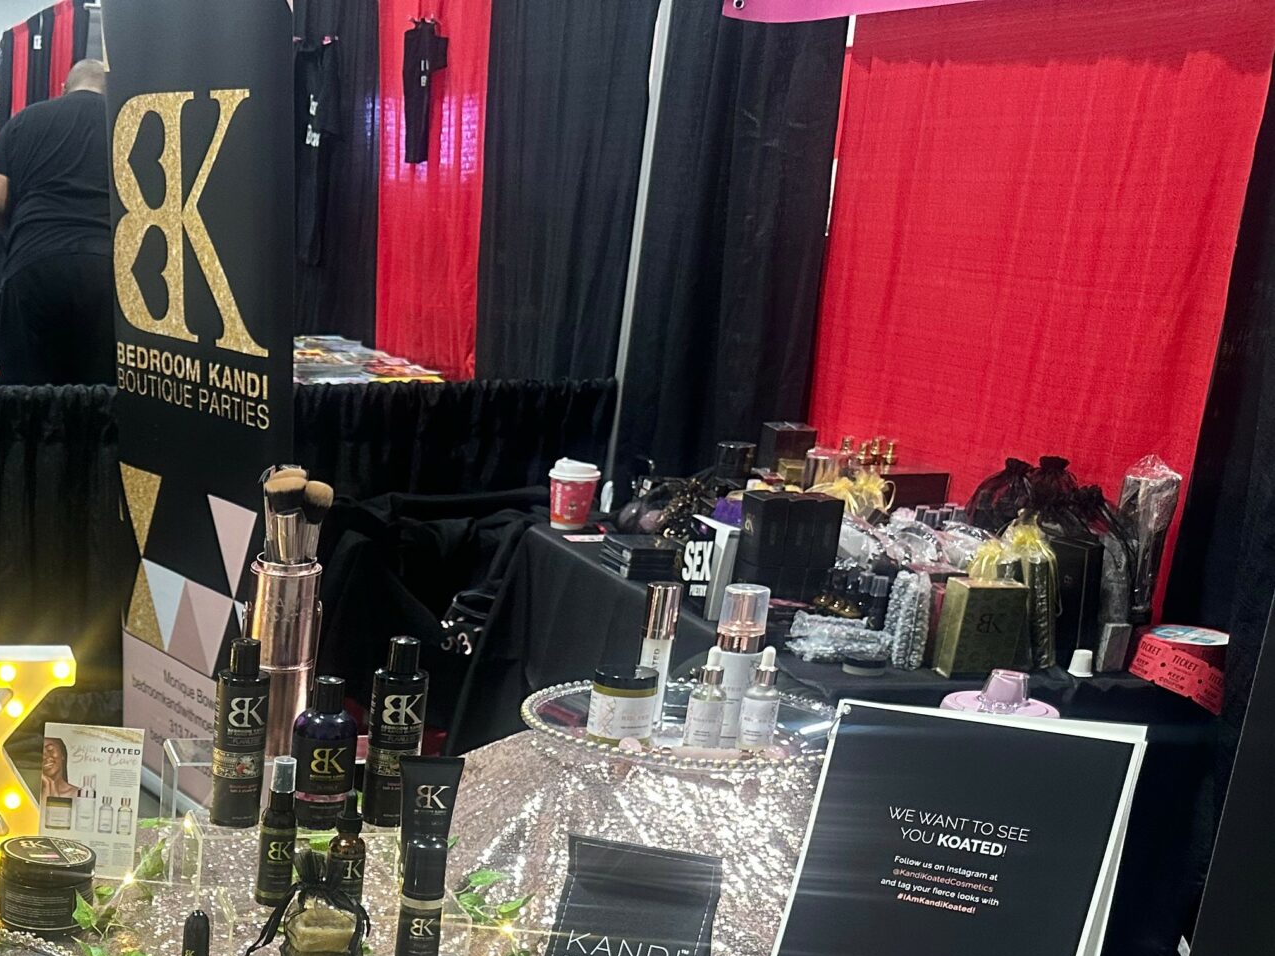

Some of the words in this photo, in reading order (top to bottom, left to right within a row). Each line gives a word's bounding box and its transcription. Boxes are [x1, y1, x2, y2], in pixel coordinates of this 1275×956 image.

[116, 341, 201, 384] BEDROOM
[208, 363, 269, 400] KANDI
[116, 367, 193, 410] BOUTIQUE
[198, 388, 270, 430] PARTIES
[682, 540, 714, 581] SEX
[1140, 641, 1162, 656] TICKET
[1172, 655, 1200, 672] TICKET
[228, 695, 267, 728] BK
[382, 693, 424, 726] BK
[101, 746, 141, 756] KOATED
[310, 747, 347, 774] BK
[889, 806, 916, 822] WE
[919, 810, 969, 832] WANT
[973, 820, 994, 836] TO
[997, 825, 1031, 842] SEE
[900, 827, 935, 844] YOU
[937, 833, 1008, 858] KOATED!
[892, 867, 994, 893] @KandiKoatedCosmetics
[894, 855, 922, 867] Follow
[922, 861, 933, 870] us
[934, 863, 945, 872] on
[946, 865, 988, 881] Instagram
[989, 873, 998, 882] at
[880, 877, 897, 887] and
[897, 880, 912, 891] tag
[912, 884, 931, 895] your
[932, 886, 956, 899] fierce
[957, 891, 980, 904] looks
[981, 896, 1000, 907] with
[897, 892, 977, 915] #IAmKandiKoated!
